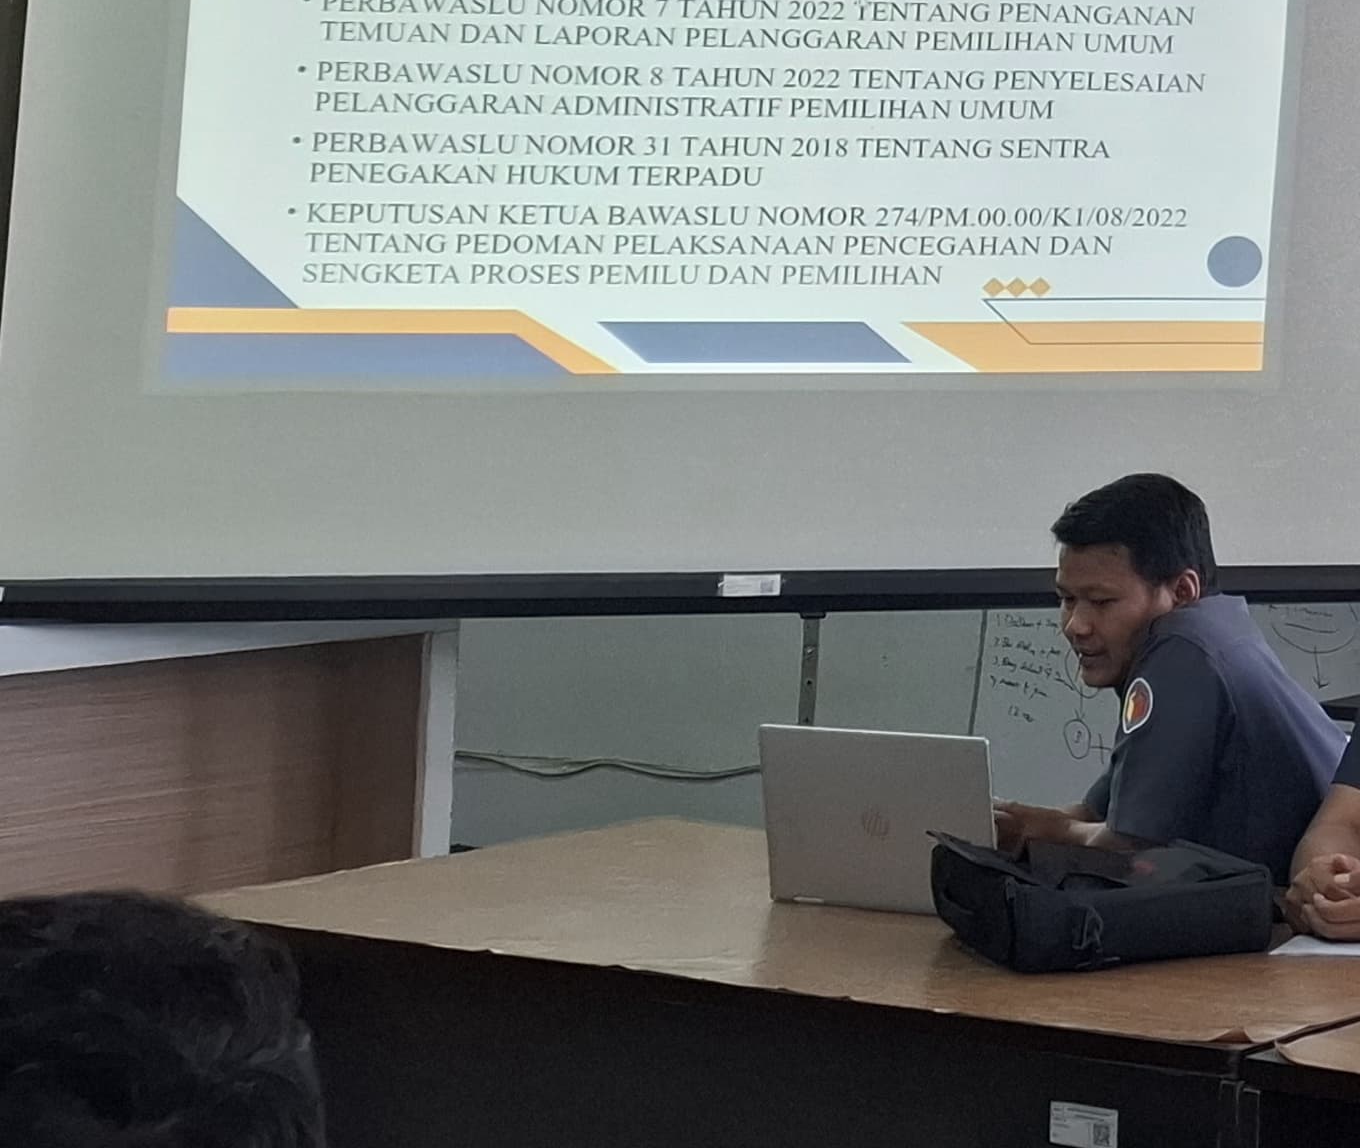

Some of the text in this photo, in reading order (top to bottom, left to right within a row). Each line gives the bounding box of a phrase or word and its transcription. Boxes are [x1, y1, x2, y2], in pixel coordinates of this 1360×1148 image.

[786, 0, 846, 21] 2022
[853, 0, 991, 23] TENTANG
[997, 2, 1195, 27] PENANGANAN
[319, 20, 1174, 55] TEMUAN DAN LAPORAN PELANGGARAN PEMILIHAN UMUM
[317, 60, 1206, 94] PERBAWASLU NOMOR 8 TAHUN 2022 TENTANG PENYELESAIAN
[315, 91, 1055, 120] PELANGGARAN ADMINISTRATIF PEMILIHAN UMUM
[311, 131, 1111, 159] PERBAWASLU NOMOR 31 TAHUN 2018 TENTANG SENTRA
[309, 162, 764, 187] PENEGAKAN HUKUM TERPADU
[306, 202, 1188, 228] KEPUTUSAN KETUA BAWASLU NOMOR 274/PM.00.00/K1/08/2022
[304, 232, 1113, 257] TENTANG PEDOMAN PELAKSANAAN PENCEGAHAN DAN
[302, 262, 943, 286] SENGKETA PROSES PEMILU DAN PEMILIHAN
